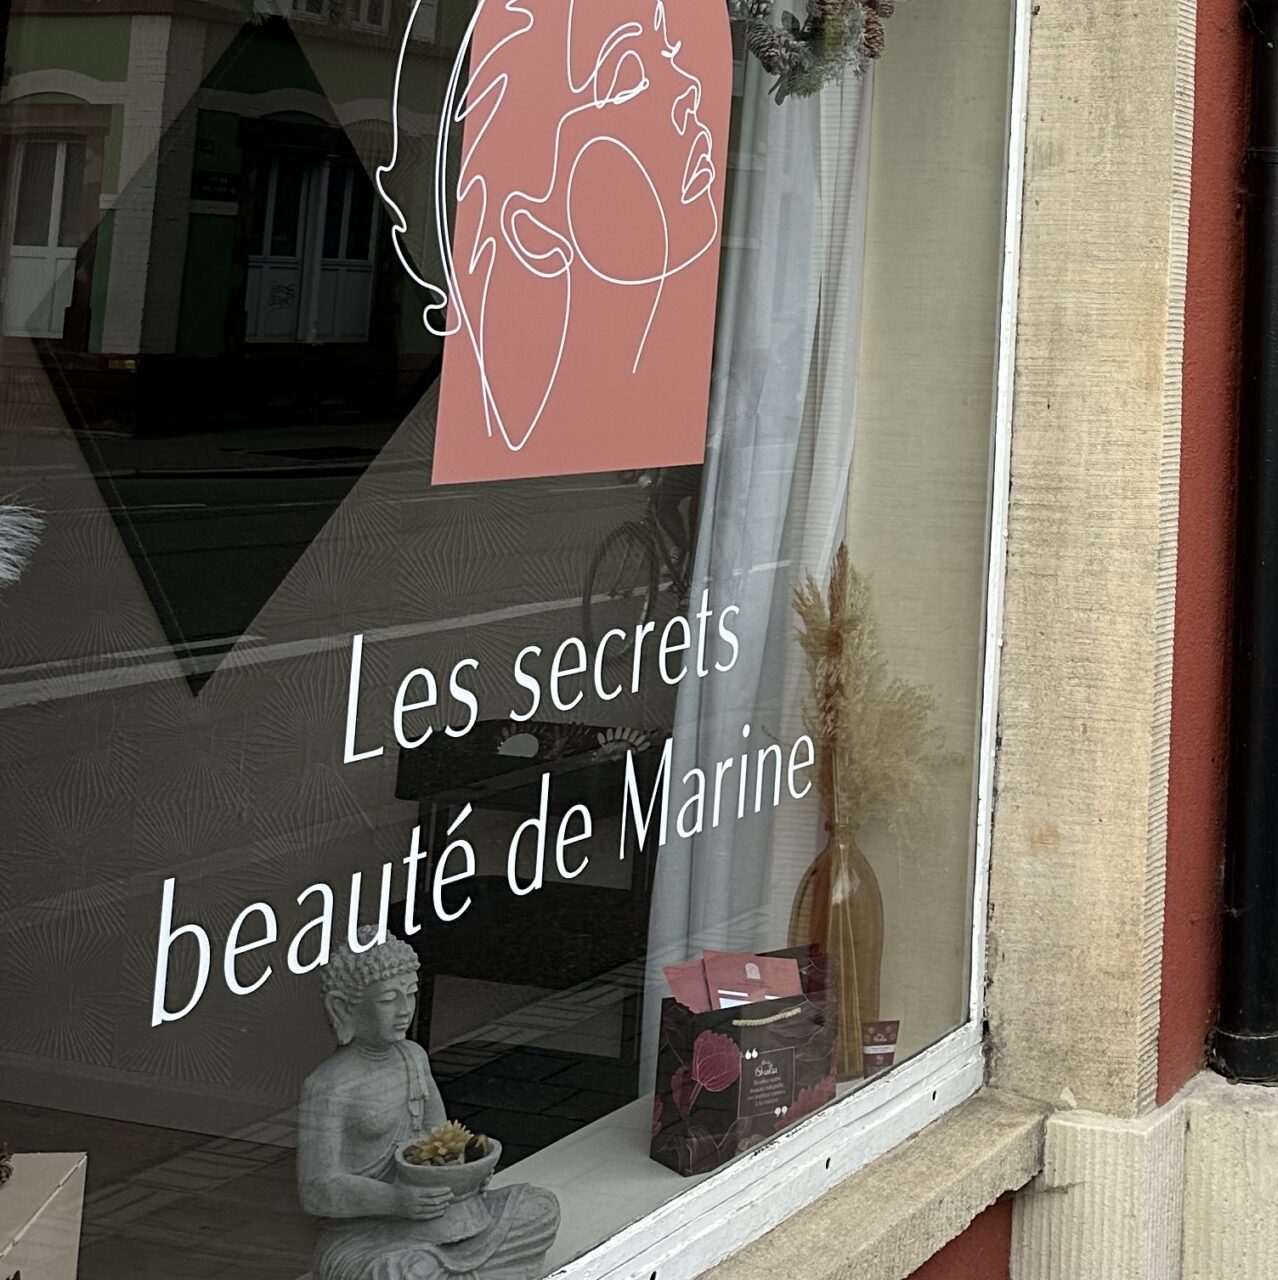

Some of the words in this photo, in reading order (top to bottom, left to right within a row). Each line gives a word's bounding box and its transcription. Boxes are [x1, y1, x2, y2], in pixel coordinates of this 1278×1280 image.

[342, 633, 480, 764] Les
[508, 587, 741, 723] secrets
[150, 802, 477, 1028] beauté
[507, 772, 594, 898] de
[619, 724, 815, 861] Marine
